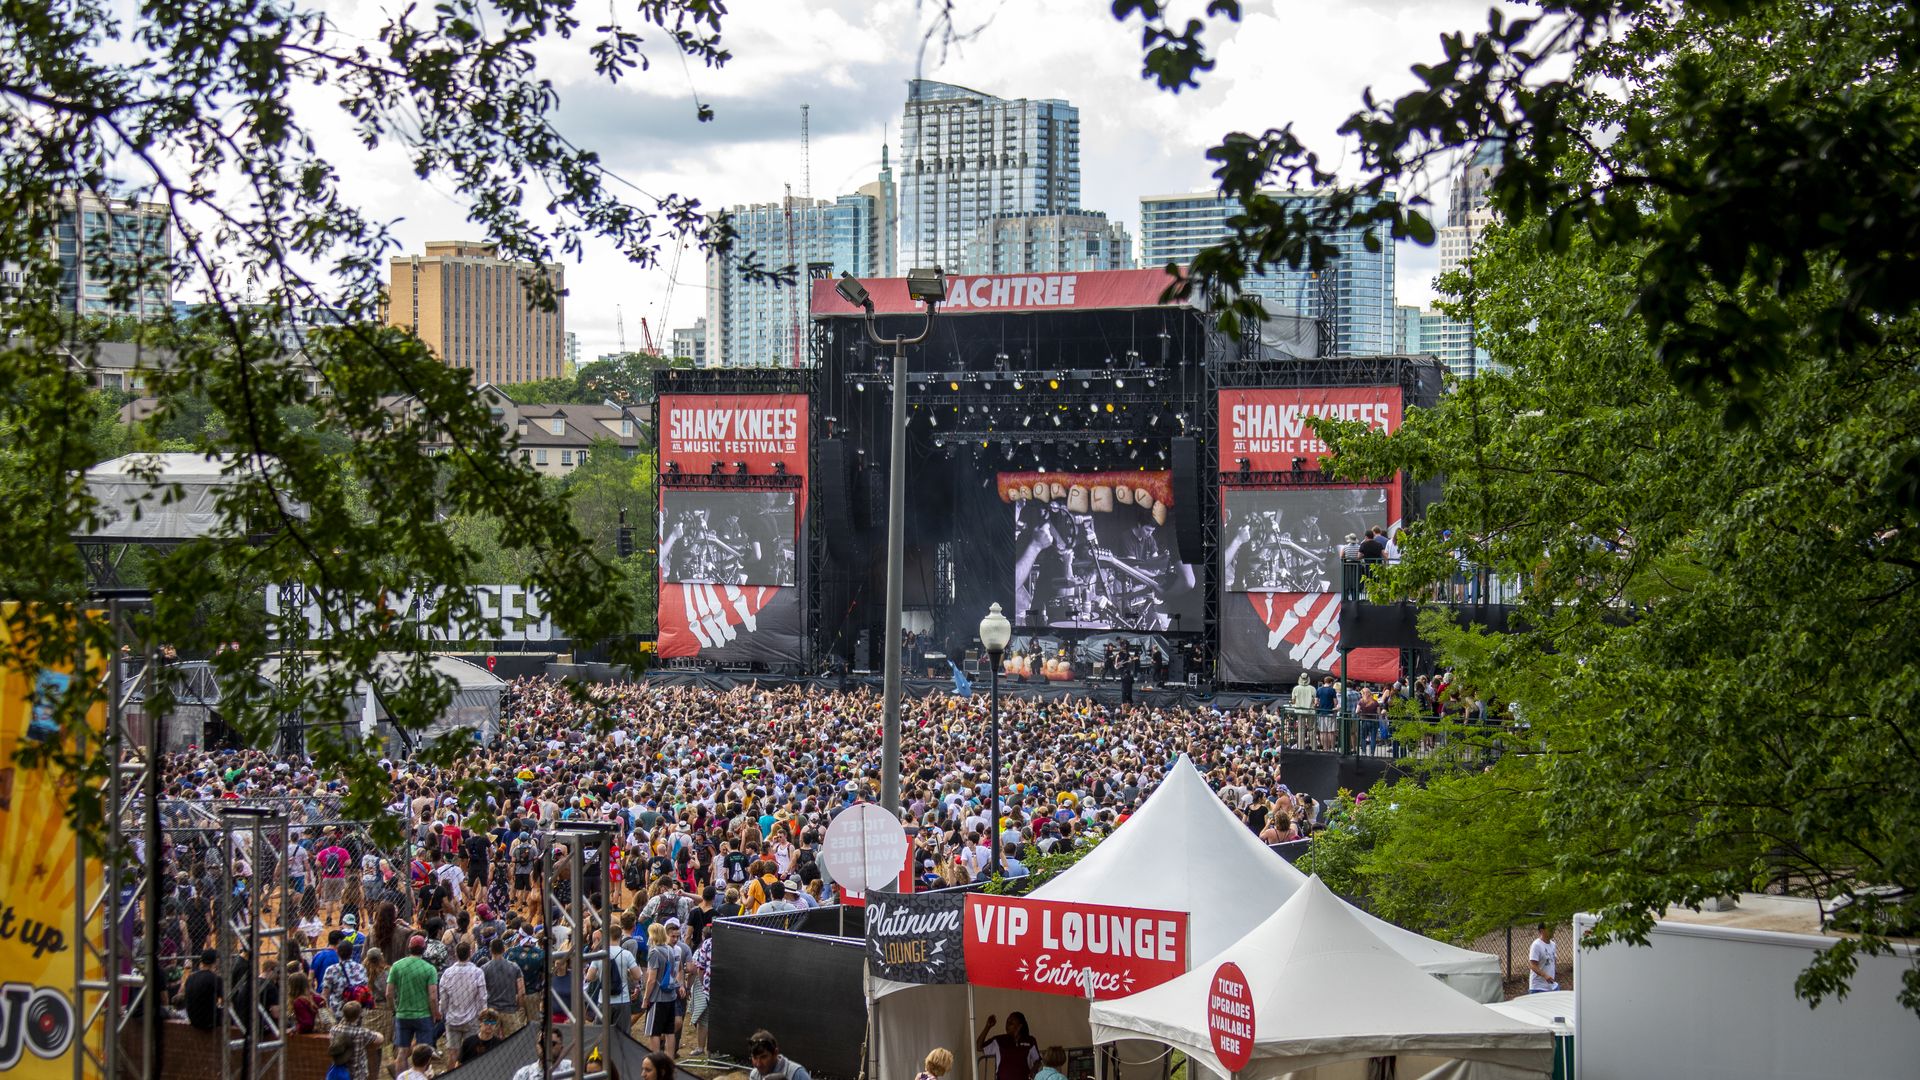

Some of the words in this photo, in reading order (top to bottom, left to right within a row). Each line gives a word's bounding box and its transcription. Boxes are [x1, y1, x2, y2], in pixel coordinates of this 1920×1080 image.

[915, 276, 1077, 308] ACHTREE
[670, 409, 733, 440] SHAKY
[735, 408, 797, 440] KNEES
[1232, 404, 1310, 438] SHAKY
[684, 441, 721, 453] MUSIC
[725, 441, 784, 453] FESTIVAL
[1234, 442, 1246, 450] ATL
[1250, 440, 1295, 453] MUSIC
[866, 903, 960, 936] Platinum
[973, 903, 1029, 946] VIP
[1042, 909, 1177, 962] LOUNGE
[20, 918, 68, 959] up
[884, 940, 927, 965] LOUNGE
[1218, 977, 1243, 999] TICKET
[1211, 994, 1251, 1020] UPGRADES
[1210, 1013, 1252, 1040] AVAILABLE
[1220, 1035, 1241, 1055] HERE
